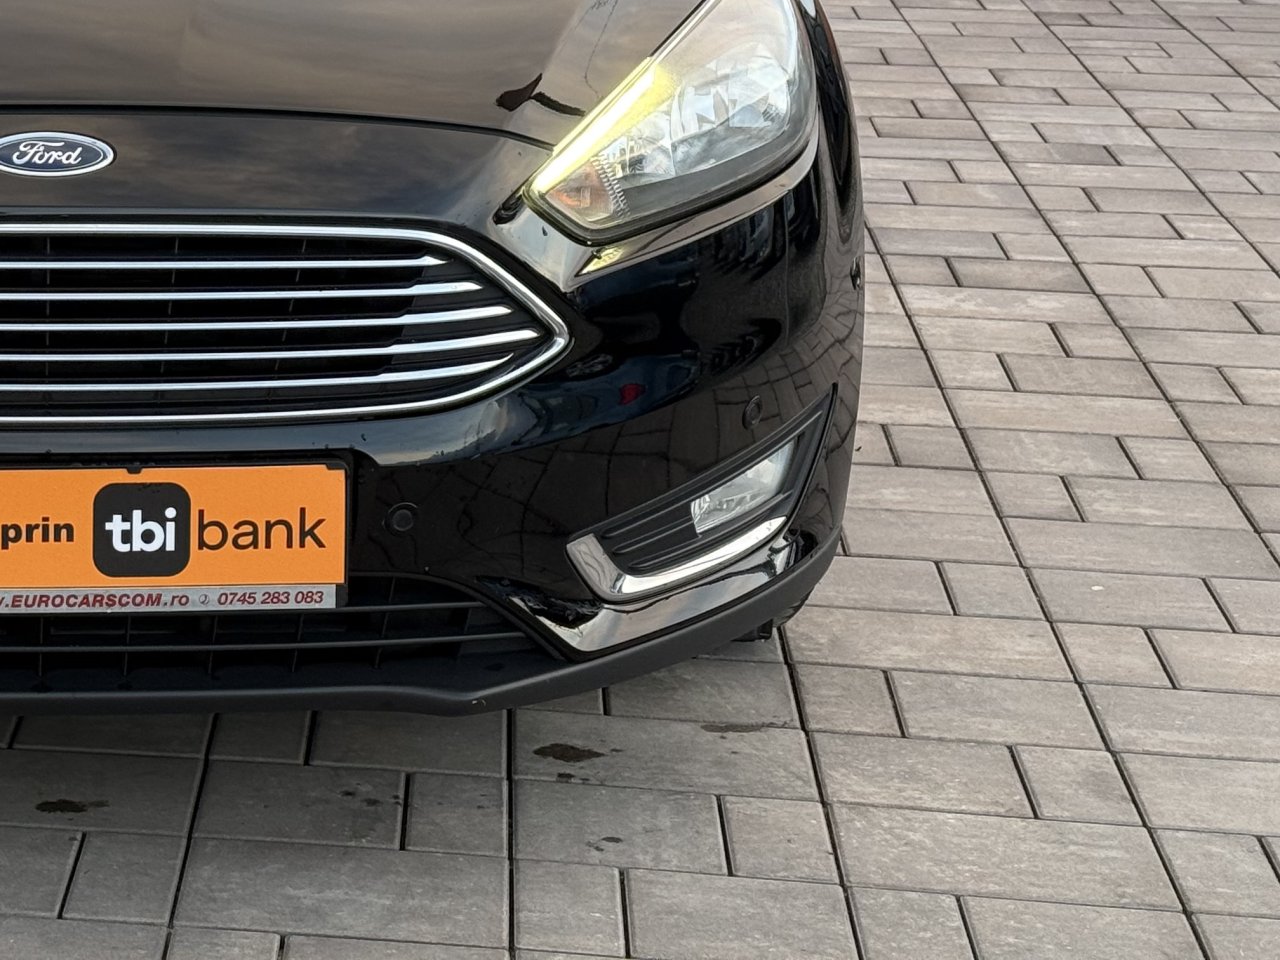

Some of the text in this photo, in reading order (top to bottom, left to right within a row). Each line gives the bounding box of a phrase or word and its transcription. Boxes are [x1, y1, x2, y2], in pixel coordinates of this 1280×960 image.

[12, 140, 82, 165] Ford
[0, 515, 75, 550] prin
[105, 506, 326, 553] tbi bank
[217, 592, 257, 605] 0745
[261, 591, 290, 605] 283
[294, 591, 324, 604] 083
